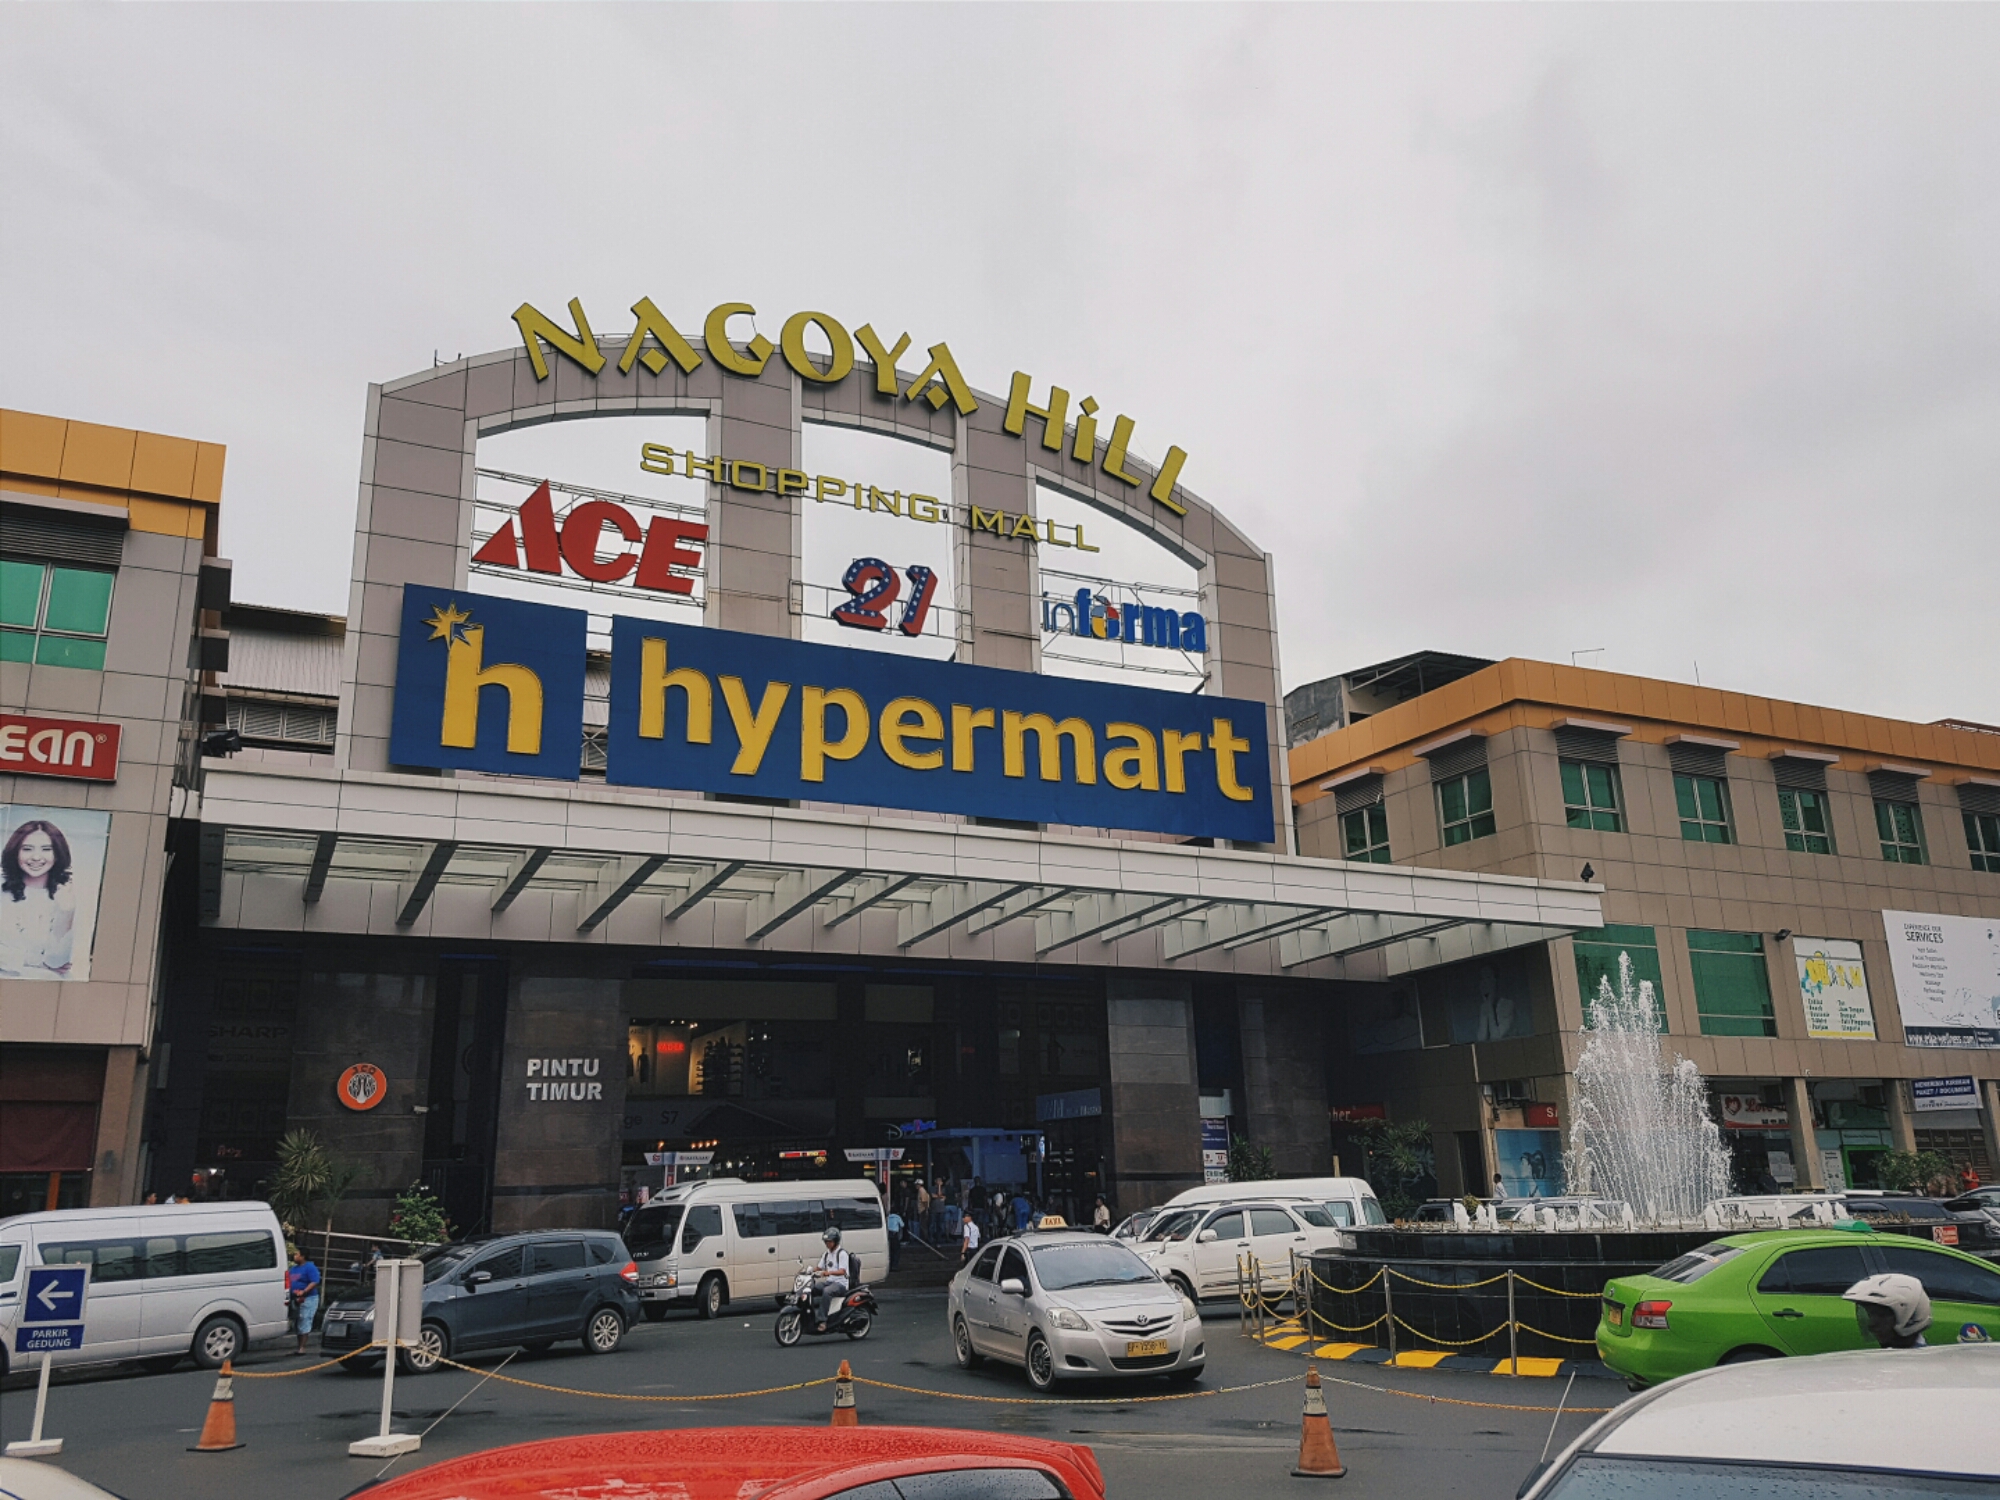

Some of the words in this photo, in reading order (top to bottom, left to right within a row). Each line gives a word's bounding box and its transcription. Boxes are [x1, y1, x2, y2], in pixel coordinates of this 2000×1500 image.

[511, 296, 979, 416] NAGOYA
[640, 442, 939, 523] SHOPPING
[970, 505, 1100, 553] MALL
[471, 478, 709, 595] ACE
[831, 557, 938, 637] 21
[1042, 587, 1209, 653] informa
[638, 635, 1254, 801] hypermart
[1905, 931, 1944, 943] SERVICES
[527, 1058, 600, 1077] PINTU
[526, 1082, 603, 1101] TIMUR
[1044, 1217, 1062, 1225] TAXI
[27, 1338, 71, 1348] GEDUNG
[32, 1328, 68, 1338] PARKIR
